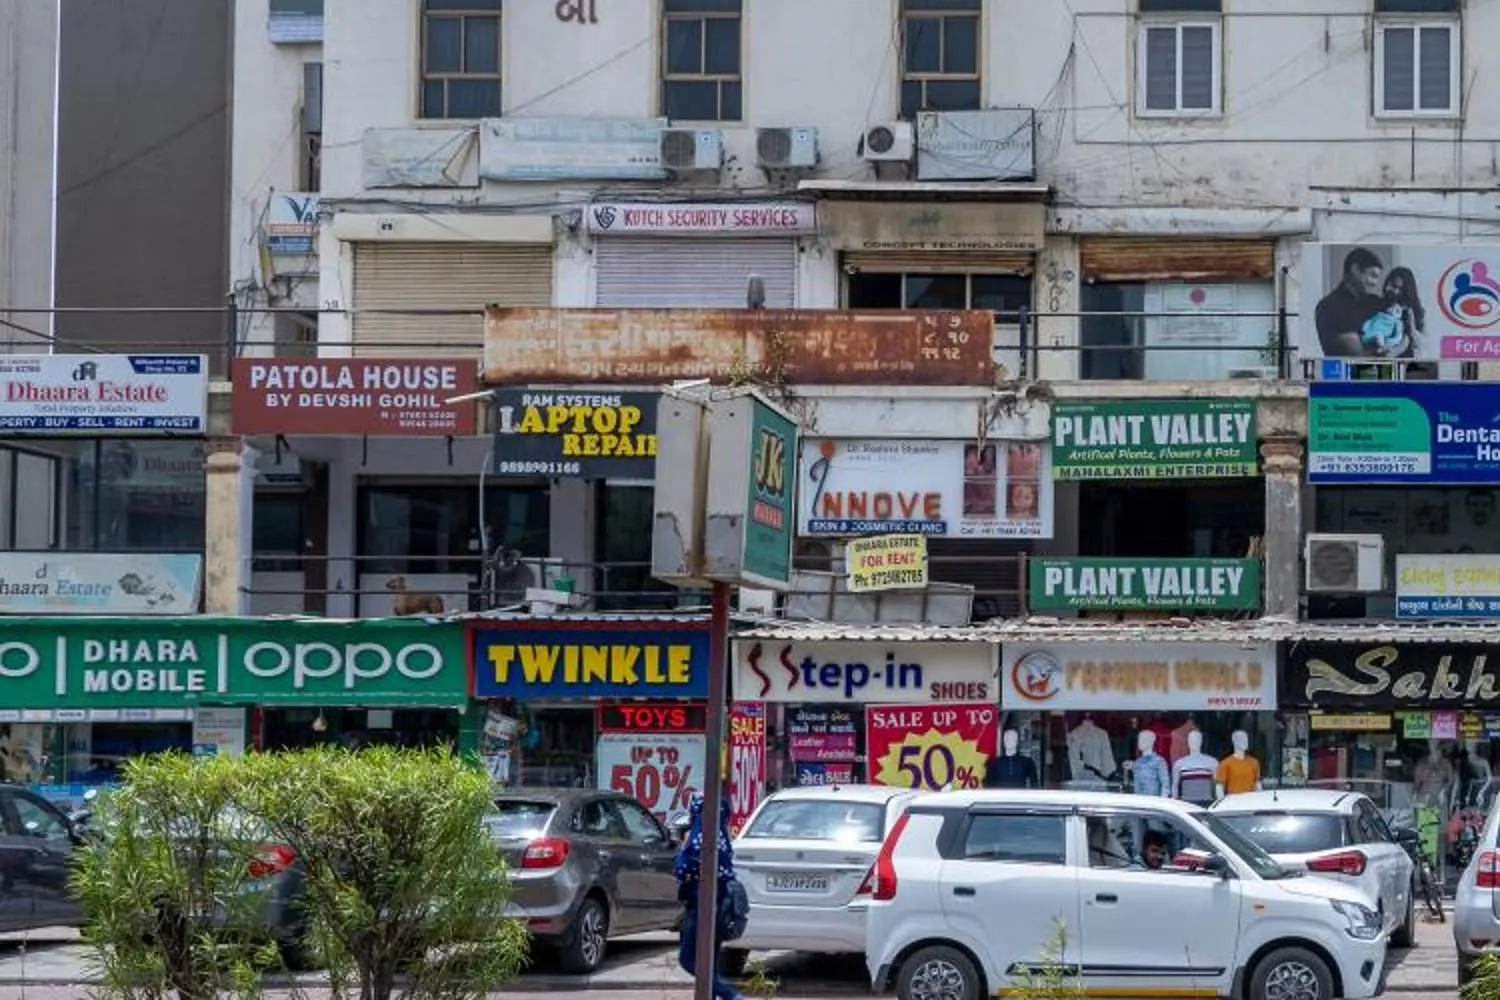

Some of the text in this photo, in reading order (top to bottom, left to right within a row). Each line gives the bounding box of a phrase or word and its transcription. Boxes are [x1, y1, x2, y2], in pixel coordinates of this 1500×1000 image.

[623, 208, 798, 227] KUTCH SECURITY SERVICES
[1455, 339, 1479, 352] For
[250, 365, 457, 389] PATOLA HOUSE
[6, 380, 169, 402] Dhaara Estate
[265, 393, 441, 408] BY DEVSHI GOHIL
[522, 393, 622, 408] RAM SYSTEMS
[45, 417, 194, 428] BUY SELL RENT INVEST
[499, 405, 641, 434] LAPTOP
[1055, 412, 1251, 447] PLANT VALLEY
[1059, 464, 1250, 479] MAHALAXMI ENTERPRISE
[907, 520, 944, 533] CLINIC
[860, 551, 918, 569] FOR RENT
[1045, 567, 1245, 597] PLANT VALLEY
[83, 639, 199, 664] DHARA
[487, 643, 692, 685] TWINKLE
[83, 669, 206, 692] MOBILE
[930, 681, 988, 700] SHOES
[619, 707, 686, 727] TOYS
[730, 716, 764, 737] SALE
[872, 711, 923, 728] SALE
[932, 710, 957, 728] UP
[965, 708, 993, 726] TO
[735, 734, 760, 745] FLAT
[630, 745, 679, 764] UP TO
[897, 743, 979, 791] 50%
[610, 764, 697, 811] 50%
